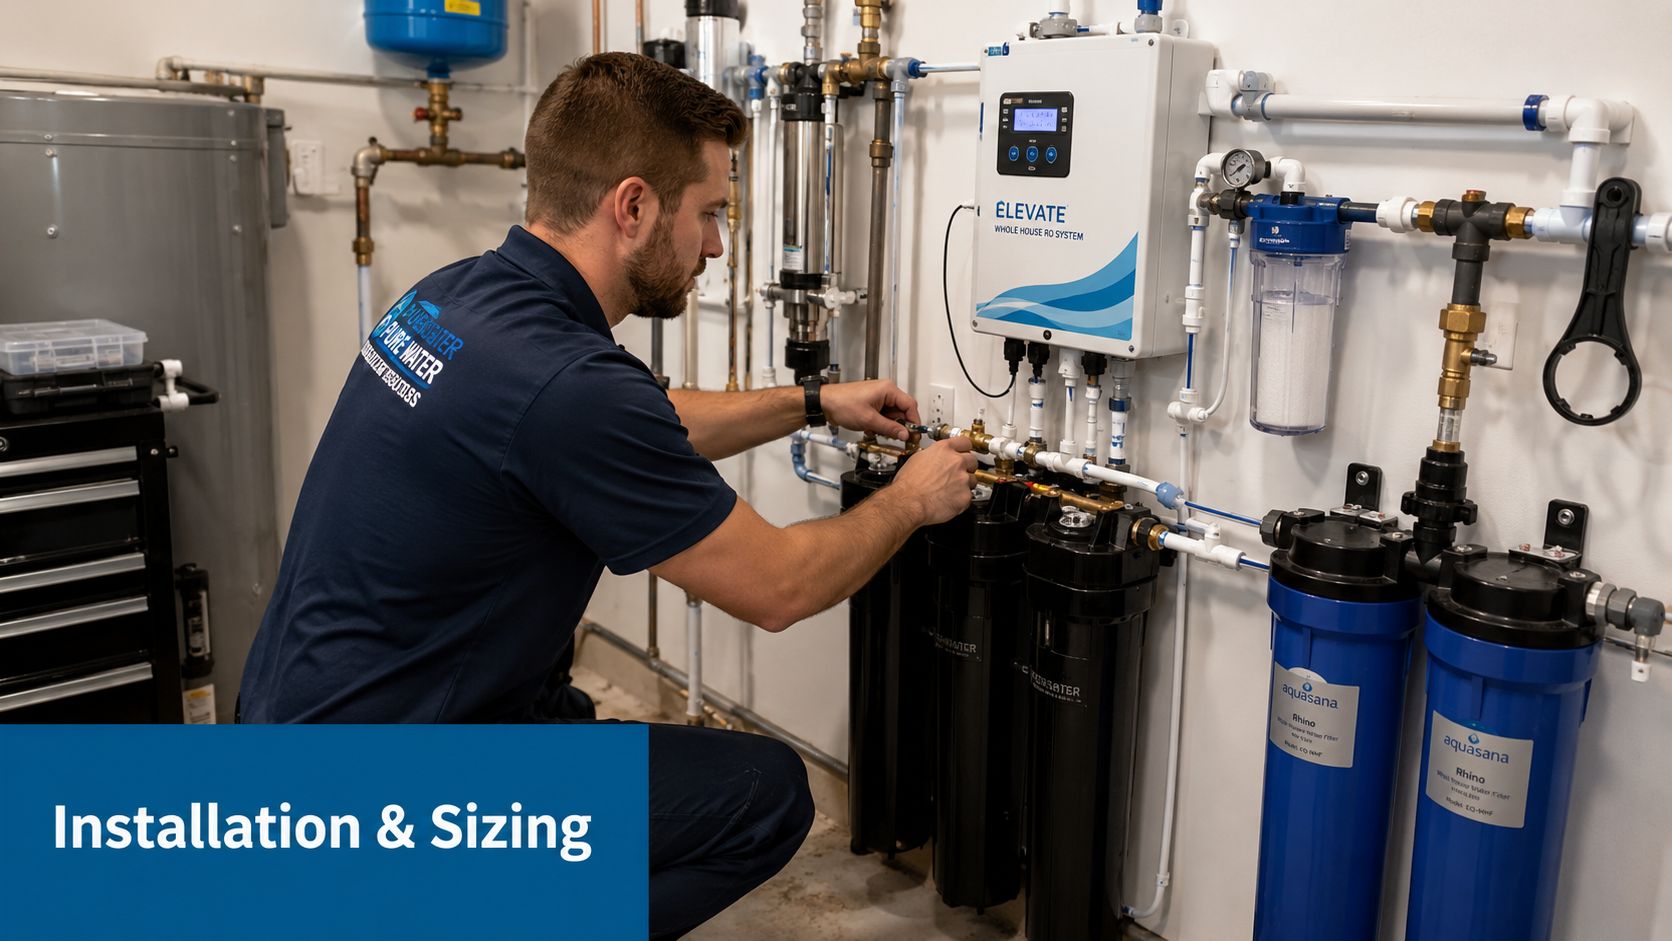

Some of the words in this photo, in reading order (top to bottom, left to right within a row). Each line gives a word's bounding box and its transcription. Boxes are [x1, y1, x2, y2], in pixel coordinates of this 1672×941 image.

[995, 200, 1067, 223] ELEVATE
[994, 225, 1018, 235] WHOLE
[1020, 226, 1042, 237] HOUSE
[1044, 228, 1054, 238] RO
[1055, 230, 1084, 241] SYSTEM
[379, 320, 412, 356] PURE
[399, 340, 444, 385] WATER
[1282, 683, 1339, 710] aquasana
[1443, 735, 1510, 764] aquasana
[1456, 767, 1486, 784] Rhino
